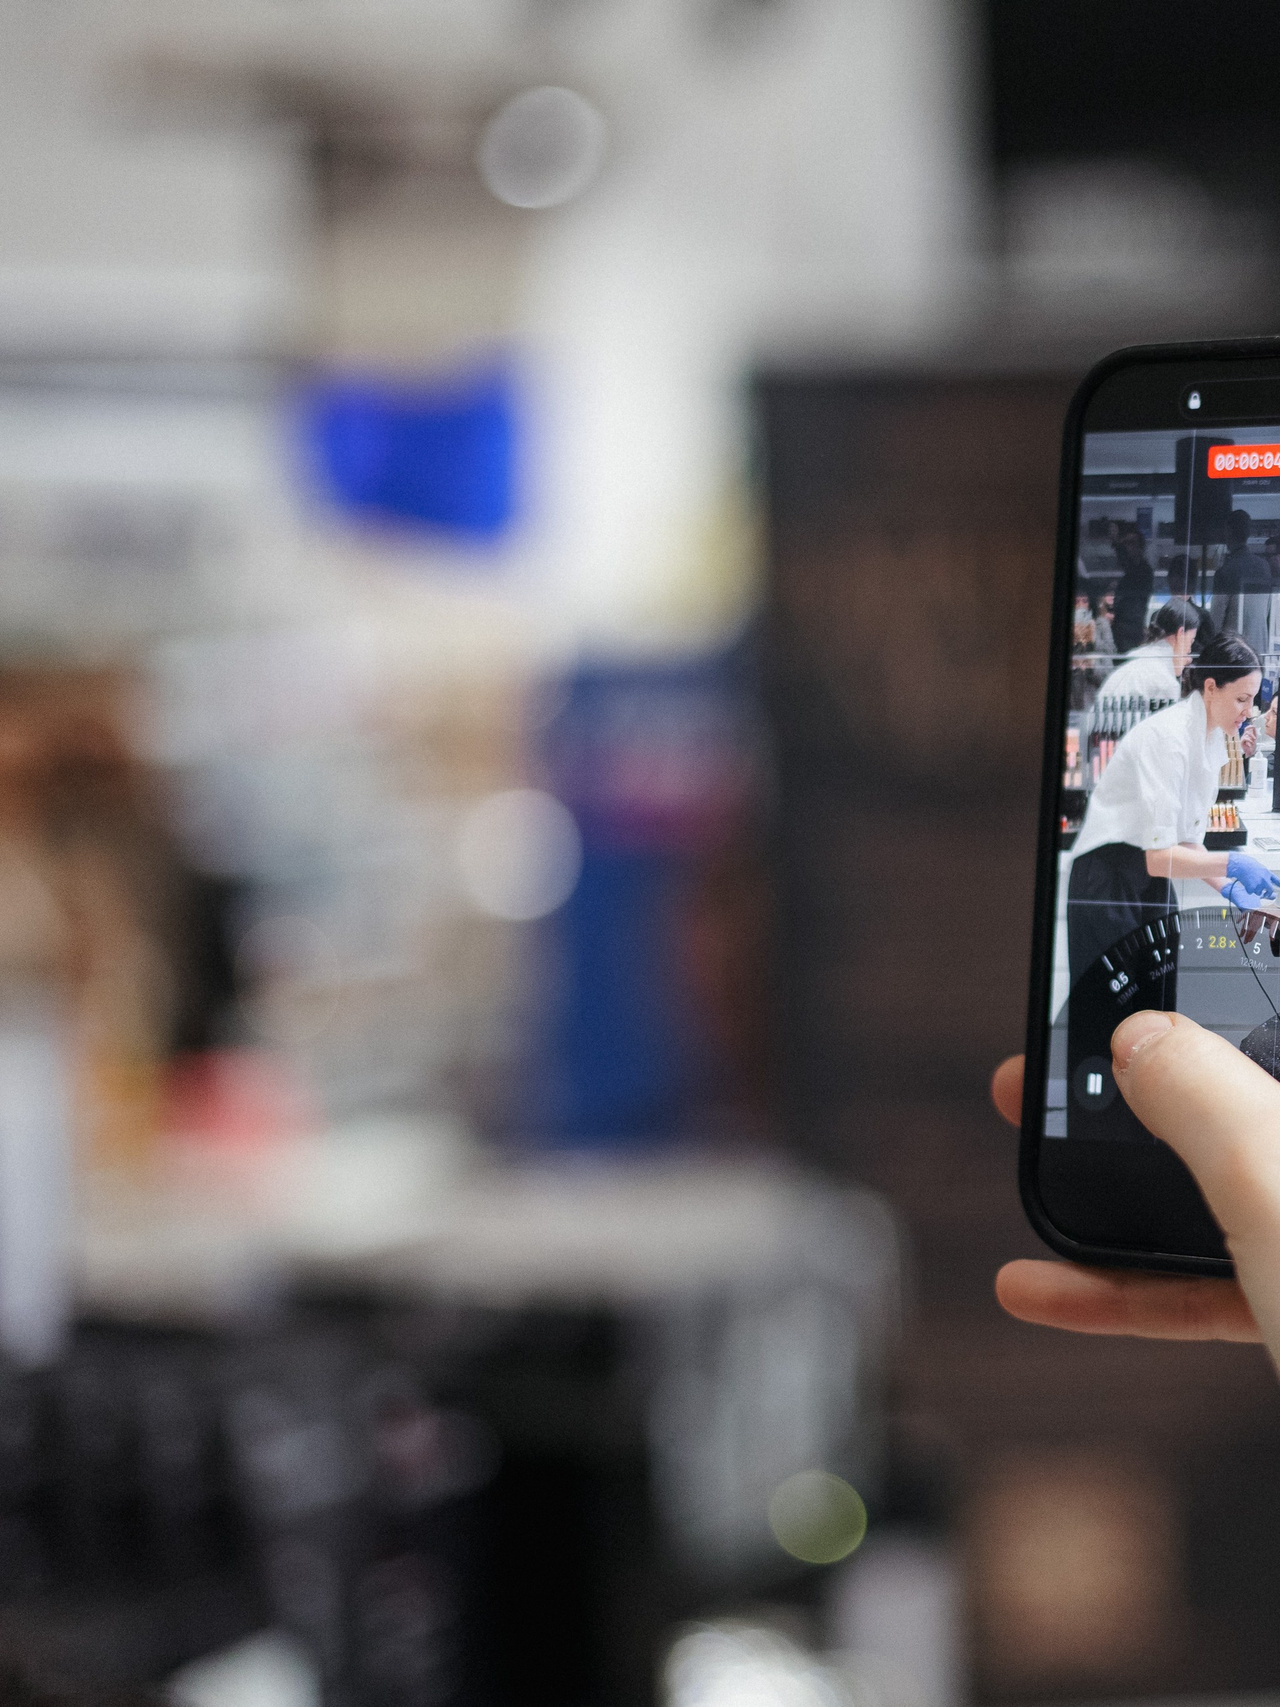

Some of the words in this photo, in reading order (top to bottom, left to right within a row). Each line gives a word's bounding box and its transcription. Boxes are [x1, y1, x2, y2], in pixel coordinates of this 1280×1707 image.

[1196, 937, 1204, 949] 2
[1253, 942, 1262, 954] 5
[1152, 949, 1161, 962] 1
[1149, 961, 1175, 980] 24MM
[1109, 971, 1129, 993] 0.5
